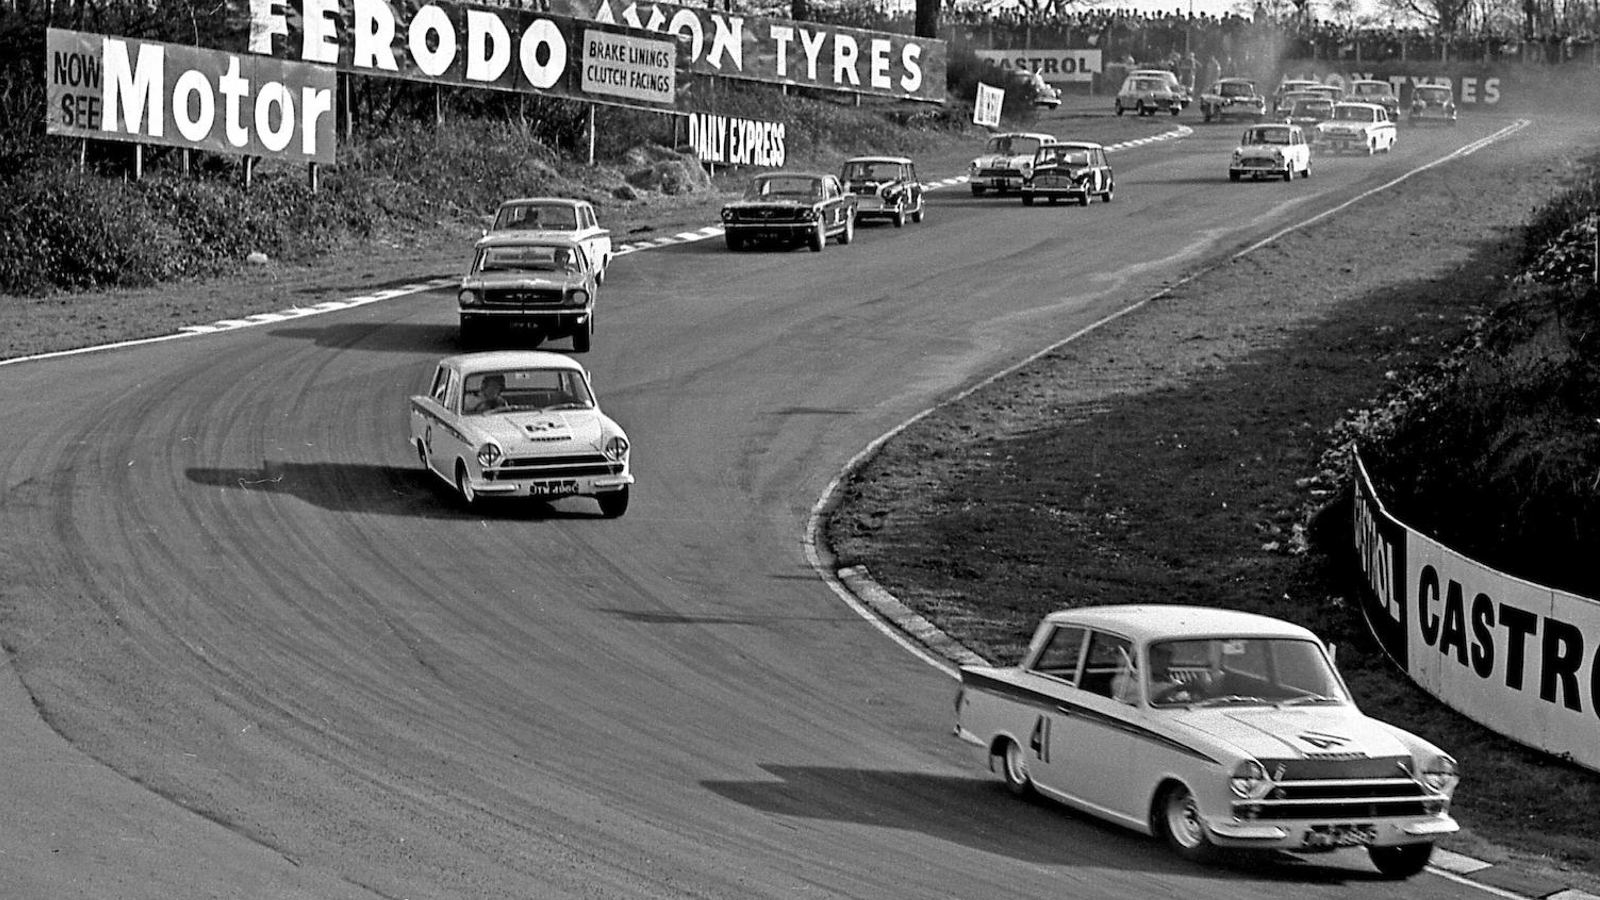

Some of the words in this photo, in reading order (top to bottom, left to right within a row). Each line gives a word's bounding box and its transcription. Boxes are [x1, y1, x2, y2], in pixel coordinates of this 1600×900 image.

[54, 51, 100, 88] NOW
[248, 0, 567, 89] FERODO
[589, 40, 626, 62] BRAKE
[629, 46, 669, 68] LININGS
[770, 25, 922, 92] TYRES
[102, 38, 331, 155] Motor
[587, 65, 627, 87] CLUTCH
[630, 71, 669, 93] FACINGS
[62, 93, 100, 130] SEE
[689, 113, 726, 162] DAILY
[729, 117, 785, 167] EXPRESS
[1418, 564, 1600, 722] CASTR
[1029, 713, 1052, 765] 41
